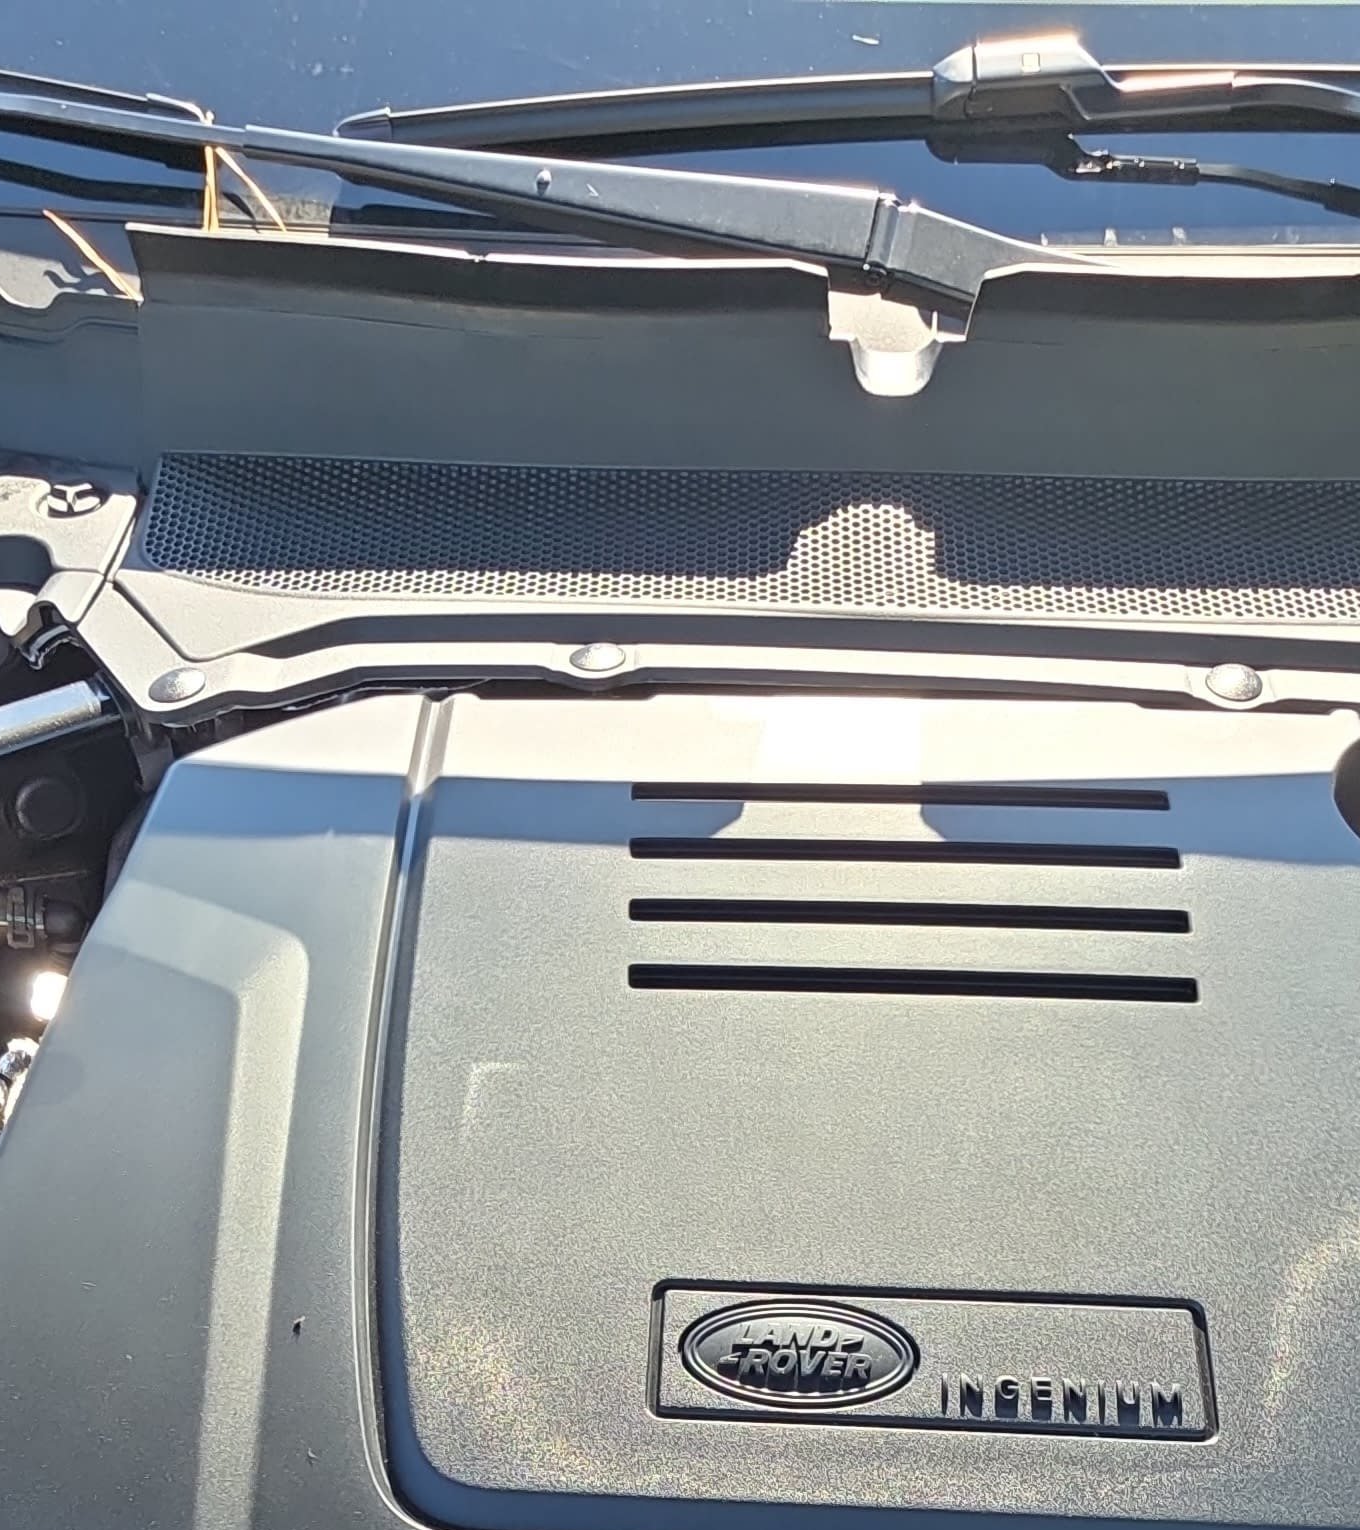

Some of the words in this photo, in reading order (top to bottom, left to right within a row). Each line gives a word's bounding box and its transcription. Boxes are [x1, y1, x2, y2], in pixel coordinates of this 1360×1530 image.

[738, 1321, 841, 1351] LAND
[741, 1347, 873, 1382] ROVER
[939, 1371, 1184, 1427] INGENIUM
